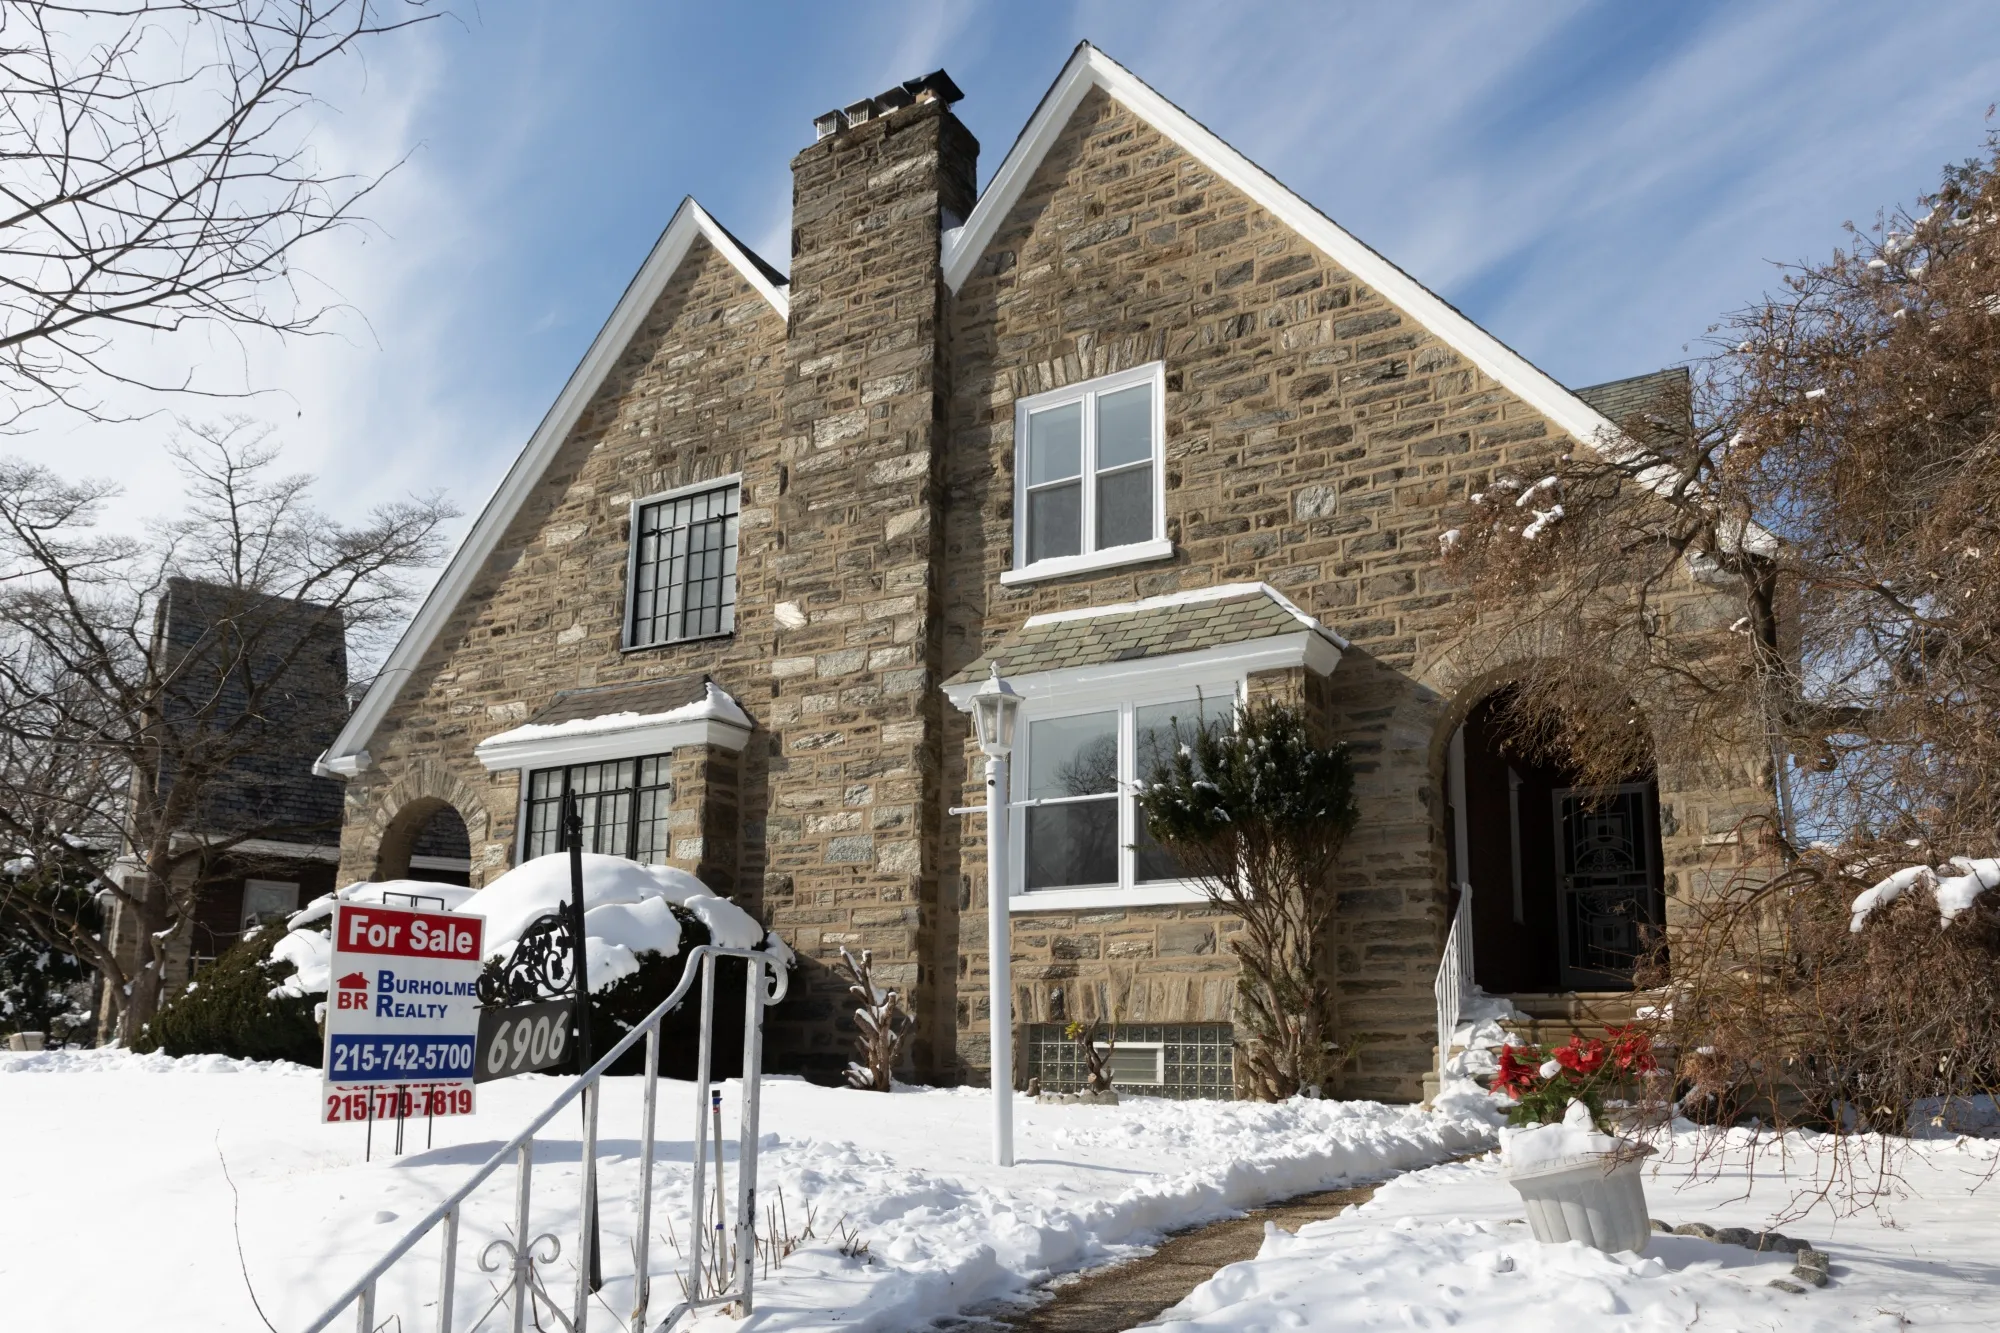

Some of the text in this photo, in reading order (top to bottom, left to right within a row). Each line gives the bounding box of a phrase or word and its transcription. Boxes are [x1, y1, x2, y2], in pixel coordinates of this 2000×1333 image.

[349, 914, 473, 954] For Sale
[377, 970, 476, 996] BURHOLME
[337, 991, 368, 1010] BR
[376, 994, 448, 1018] REALTY
[488, 1011, 568, 1074] 6906
[334, 1043, 472, 1071] 215-742-5700
